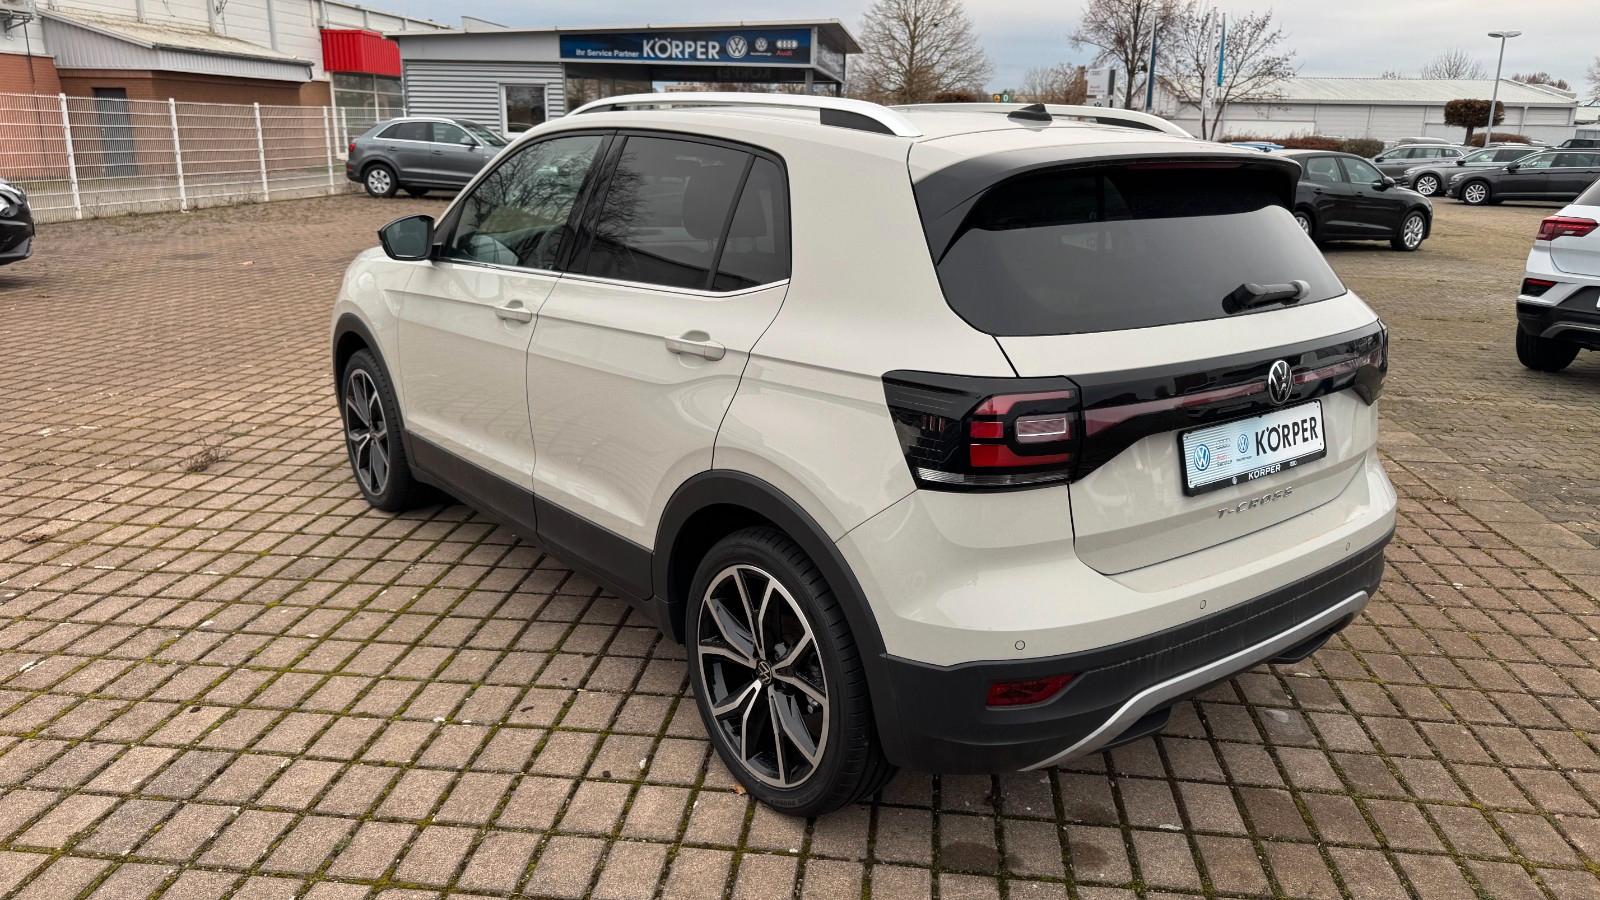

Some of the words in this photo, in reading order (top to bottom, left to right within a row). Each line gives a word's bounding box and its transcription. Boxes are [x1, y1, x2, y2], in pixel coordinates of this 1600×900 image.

[587, 49, 612, 57] Service
[613, 50, 640, 58] Partner
[643, 38, 720, 59] KÖRPER
[1255, 416, 1319, 456] KÖRPER
[1217, 485, 1294, 520] T-CROSS
